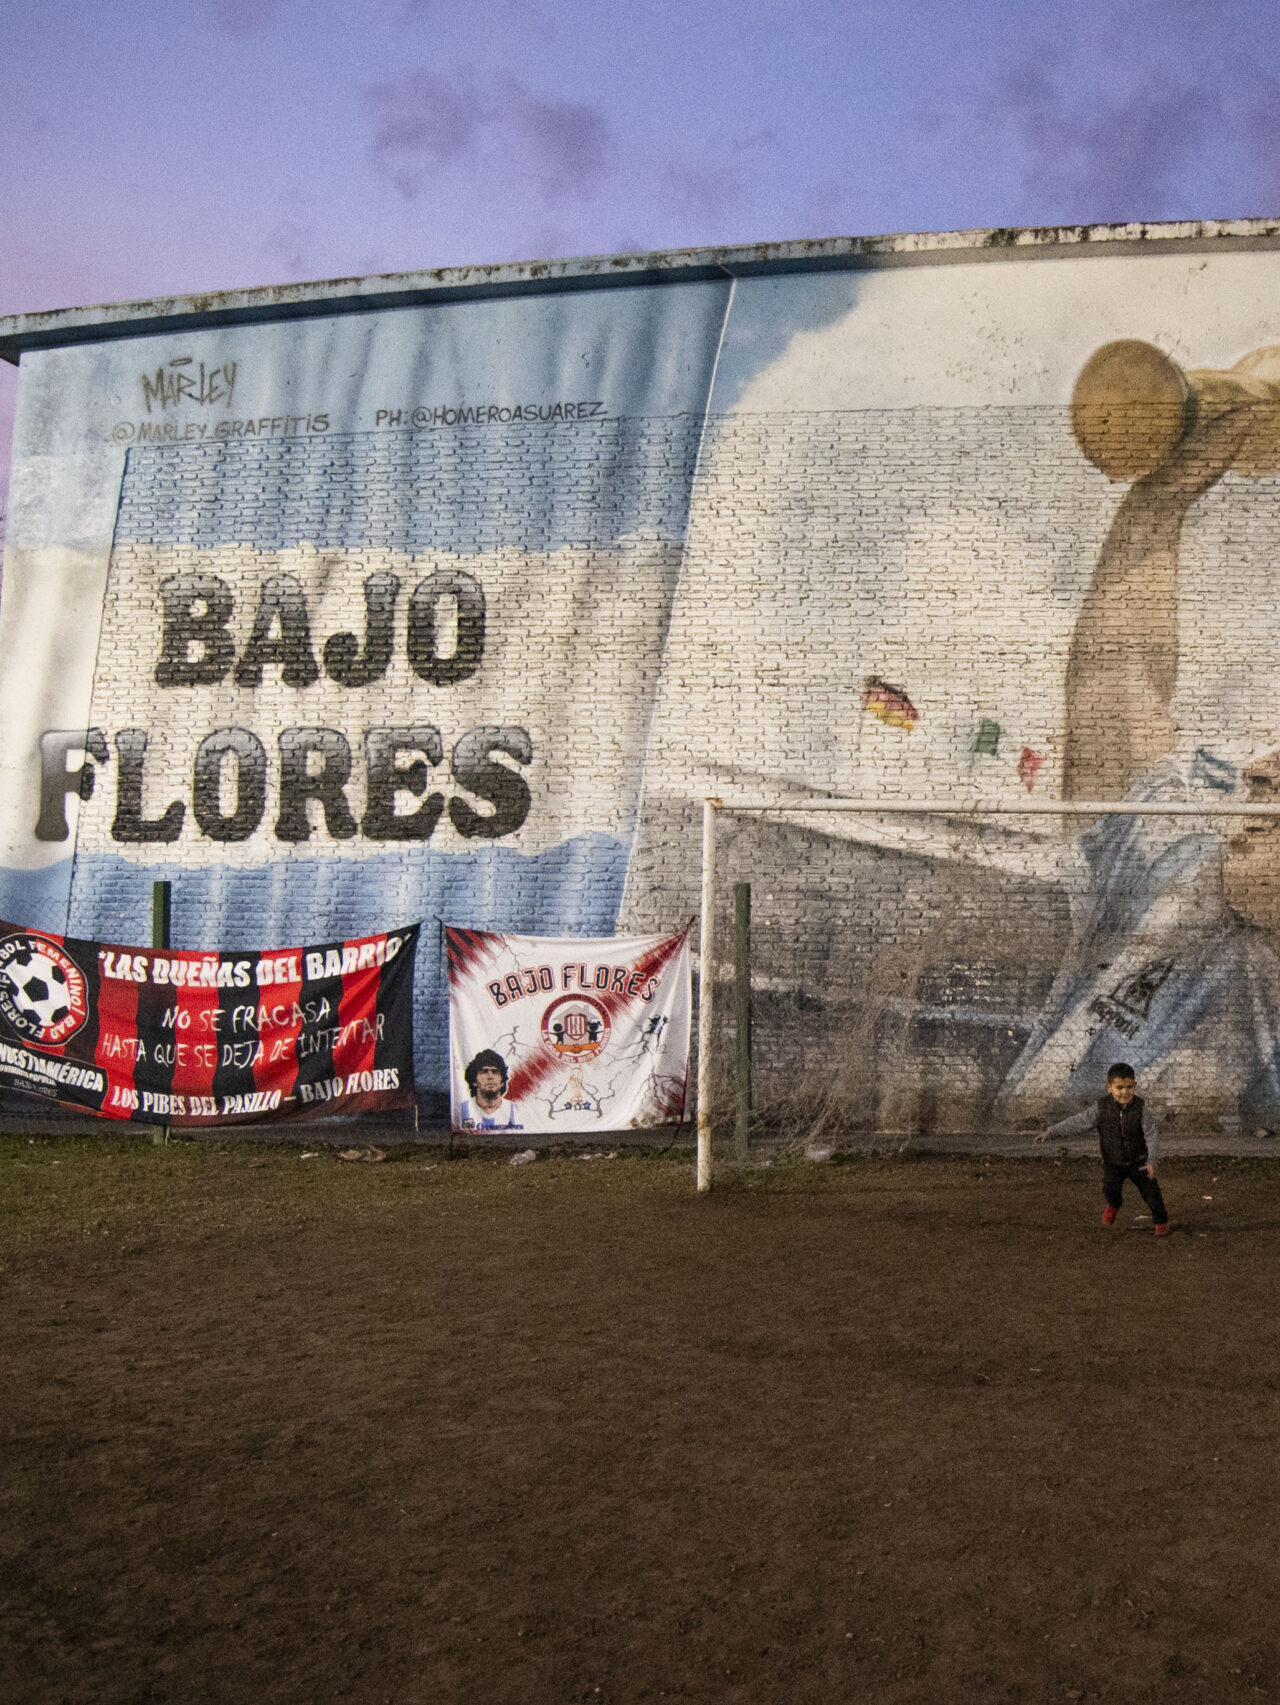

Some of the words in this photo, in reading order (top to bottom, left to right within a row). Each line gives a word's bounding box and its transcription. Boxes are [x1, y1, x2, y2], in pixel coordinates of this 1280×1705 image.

[142, 360, 237, 413] MARLEY
[375, 408, 409, 427] PH:
[411, 401, 608, 429] @HOMEROASUAREZ
[154, 570, 488, 688] BAJO
[35, 726, 534, 842] FLORES
[153, 956, 250, 988] DUEÑAS
[256, 955, 302, 986] DEL
[486, 964, 556, 1009] BAJO
[560, 962, 661, 1004] FLORES
[162, 1005, 190, 1030] NO
[200, 1008, 224, 1032] SE
[233, 997, 331, 1033] FRACASA
[102, 1033, 147, 1063] HASTA
[154, 1043, 188, 1068] QUE
[194, 1044, 217, 1068] SE
[222, 1038, 264, 1069] DEJA
[270, 1037, 294, 1062] DE
[298, 1013, 386, 1058] INTENTAR
[110, 1085, 139, 1111] LOS
[142, 1091, 187, 1116] PIBES
[189, 1095, 219, 1117] DEL
[221, 1089, 282, 1116] PASILLO
[300, 1077, 343, 1103] BAJO
[345, 1067, 400, 1095] FLORES
